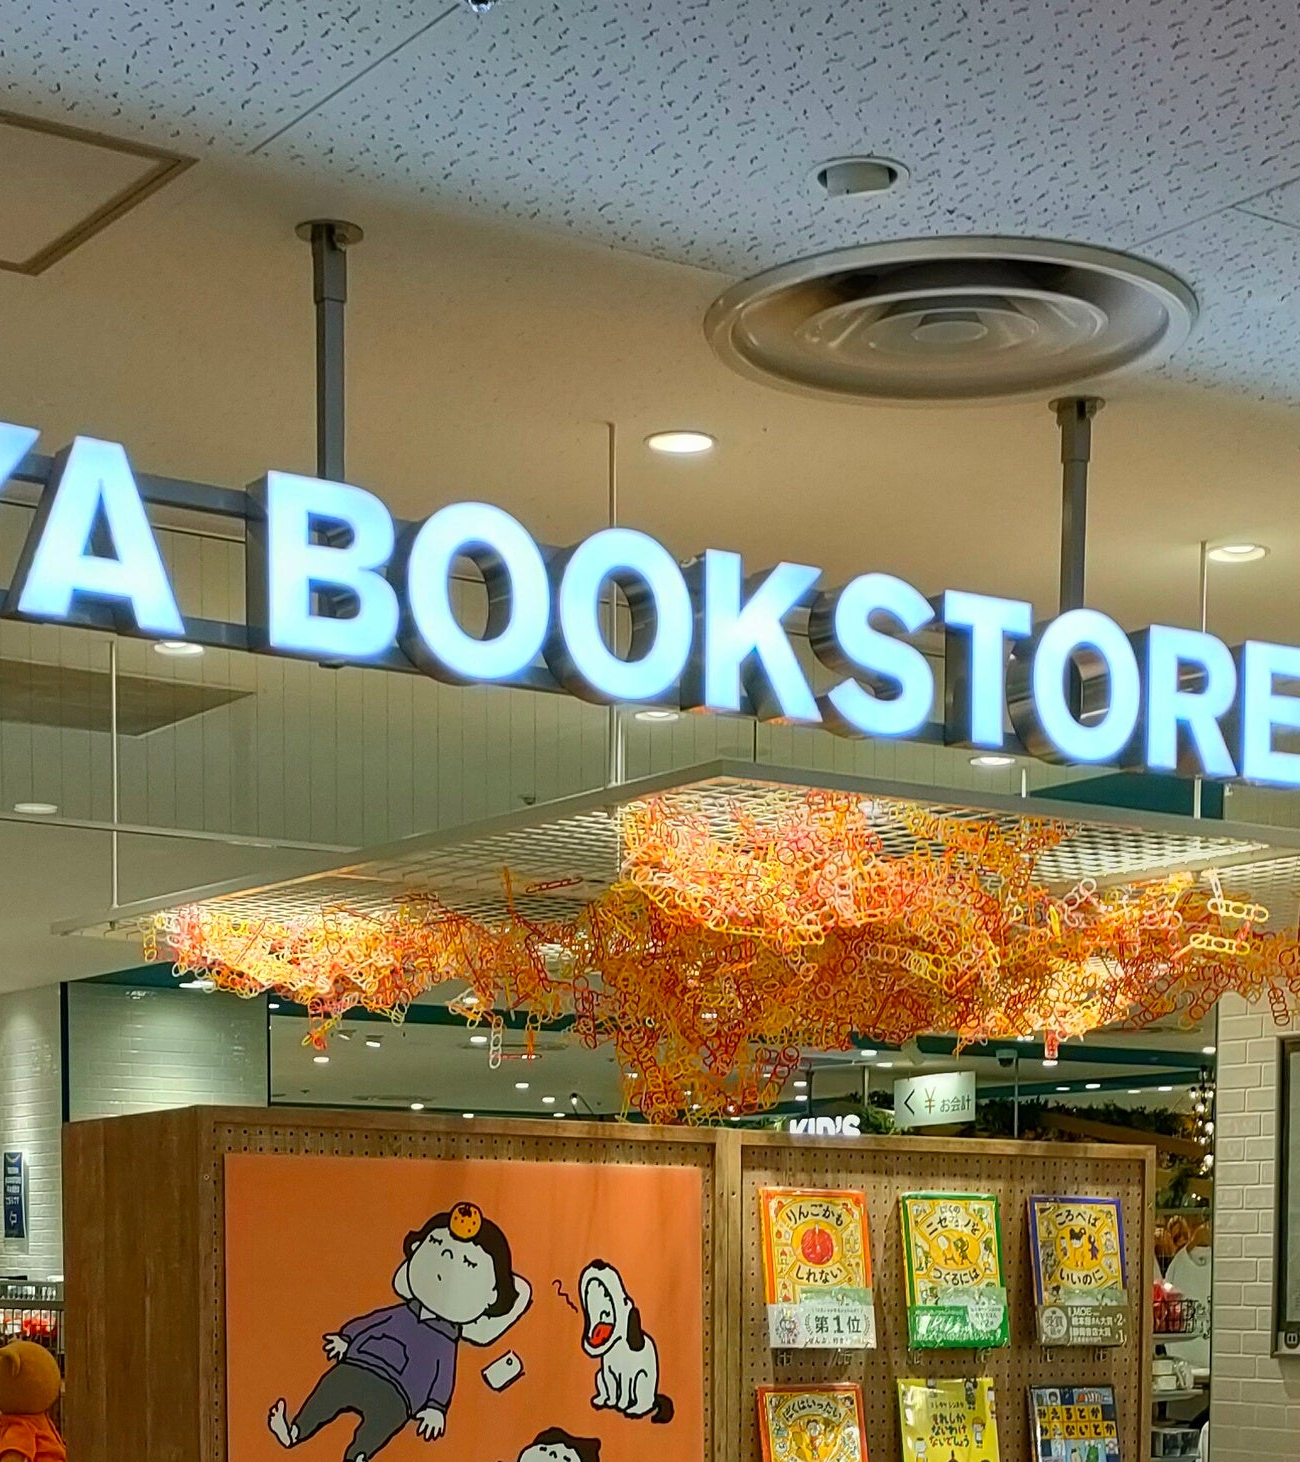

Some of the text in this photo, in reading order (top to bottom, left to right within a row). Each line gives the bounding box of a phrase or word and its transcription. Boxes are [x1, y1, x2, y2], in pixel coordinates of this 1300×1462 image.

[940, 1095, 972, 1112] お会計
[786, 1204, 843, 1227] りんごかも
[1055, 1210, 1101, 1227] ころべば
[796, 1265, 843, 1284] しれない
[933, 1267, 980, 1286] つくるには
[1060, 1268, 1104, 1285] いいのに
[815, 1315, 862, 1334] 第1位
[783, 1399, 842, 1421] ぼくはいったい
[932, 1413, 966, 1424] それしか
[1037, 1407, 1101, 1421] みえるとか
[931, 1425, 967, 1436] ないわけ
[929, 1435, 970, 1447] ないでしょう
